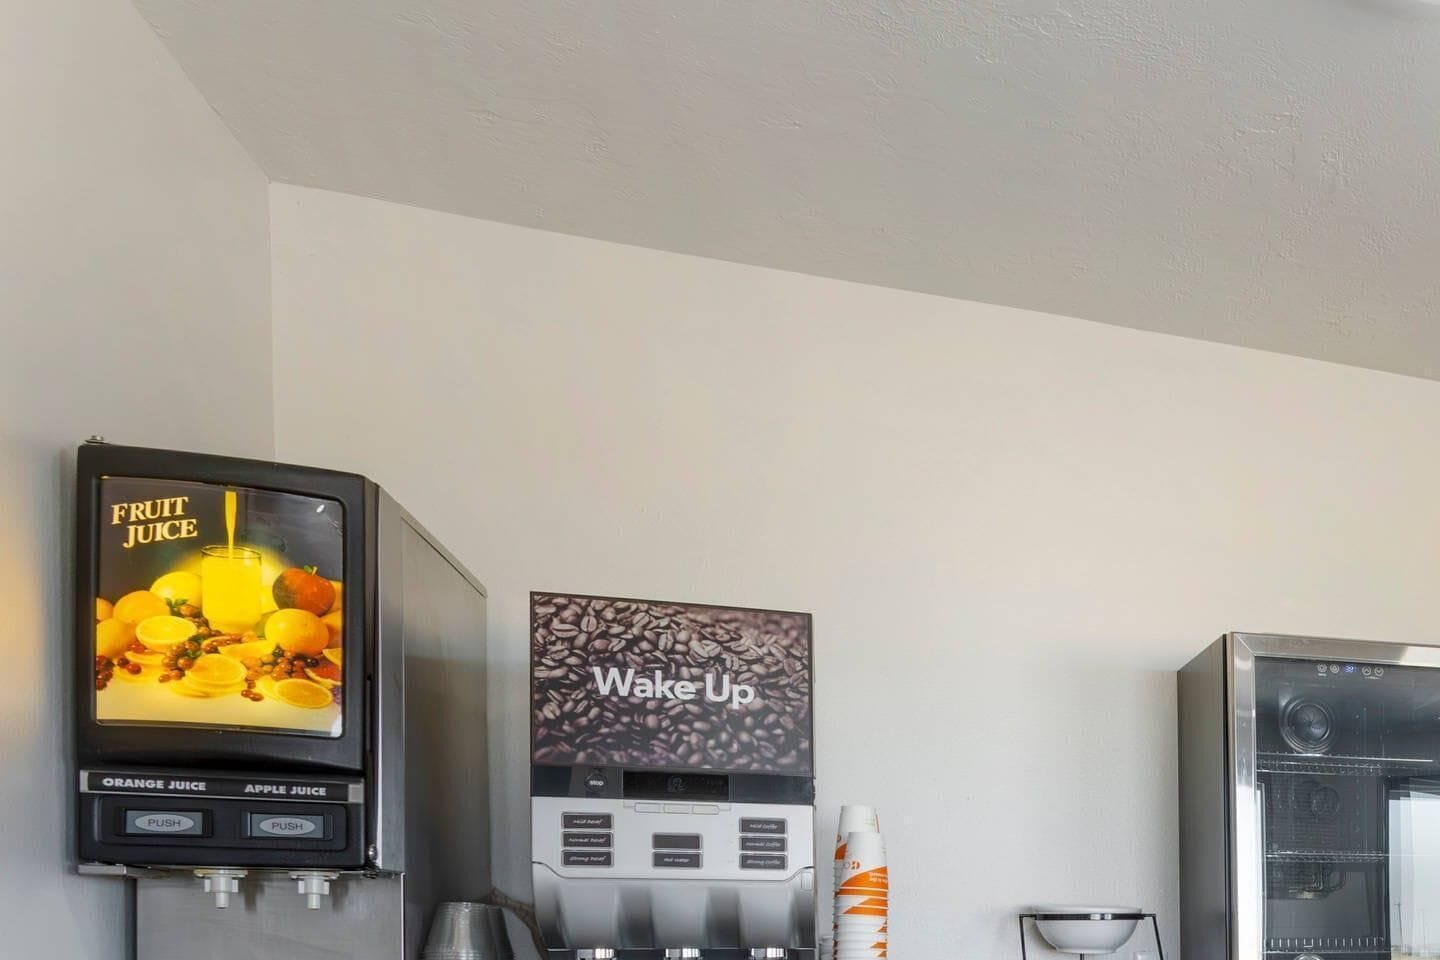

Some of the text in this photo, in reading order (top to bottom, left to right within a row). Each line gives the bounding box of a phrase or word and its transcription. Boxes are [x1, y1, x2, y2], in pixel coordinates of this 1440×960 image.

[111, 496, 189, 525] FRUIT
[122, 518, 198, 548] JUICE
[592, 666, 755, 710] Wake Up
[102, 777, 207, 791] ORANGE JUICE
[244, 784, 327, 796] APPLE JUICE
[147, 818, 181, 828] PUSH
[271, 821, 303, 831] PUSH
